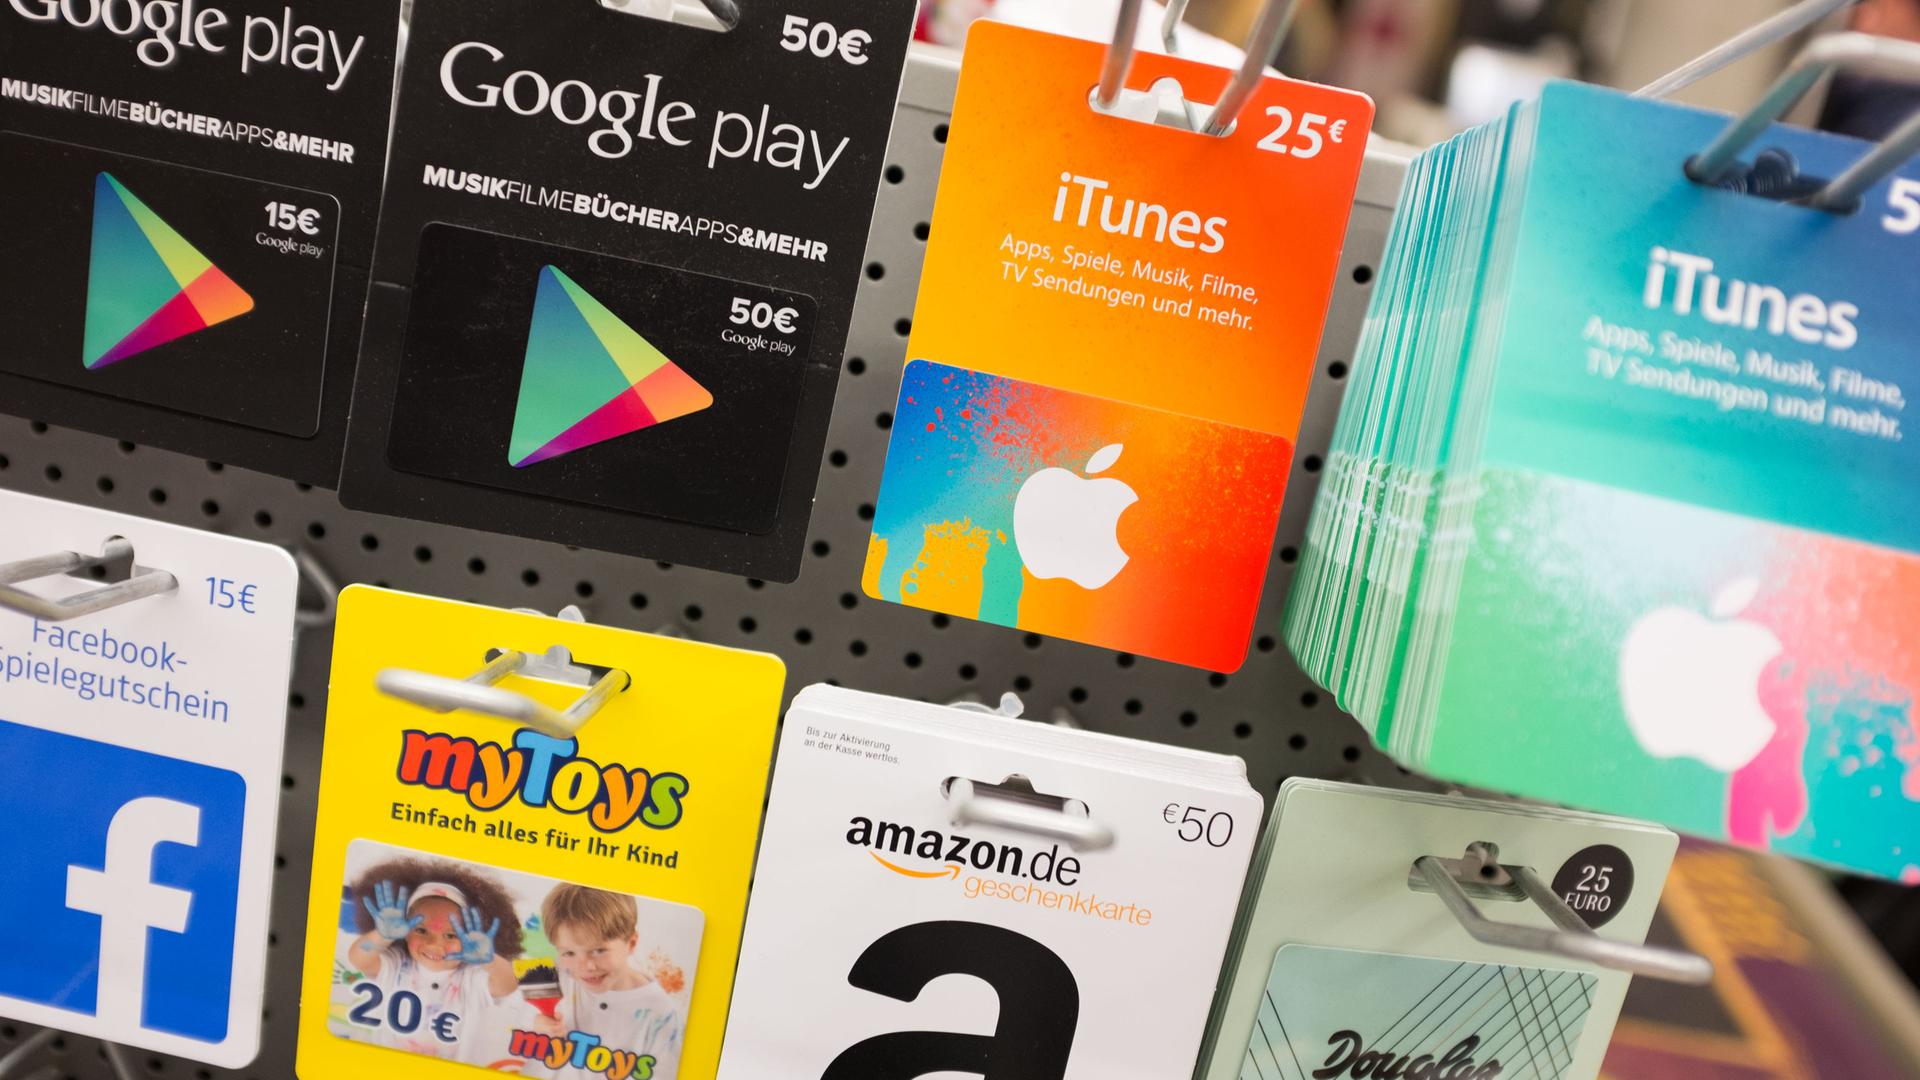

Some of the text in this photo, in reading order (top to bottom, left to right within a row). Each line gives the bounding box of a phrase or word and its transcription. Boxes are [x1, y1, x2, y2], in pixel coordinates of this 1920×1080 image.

[241, 6, 366, 91] play
[780, 14, 873, 65] 50€
[1, 77, 355, 164] MUSIKFILMEBÜCHERAPPS&MEHR
[440, 41, 850, 190] Google play
[1256, 105, 1347, 159] 25€
[255, 232, 324, 259] Google play
[264, 201, 321, 235] 15€
[422, 164, 829, 262] MUSIKFILMEBÜCHERAPPS&MEHR
[1053, 171, 1228, 254] iTunes
[1000, 233, 1260, 305] Apps, Spiele, Musik, Filme,
[1000, 261, 1254, 331] TV Sendungen und mehr.
[1643, 245, 1859, 350] iTunes
[721, 329, 797, 357] Google play
[729, 296, 799, 334] 50€
[1582, 315, 1906, 410] Apps, Spiele, Musik, Filme,
[1586, 346, 1903, 441] TV Sendungen und mehr.
[205, 576, 258, 614] 15€
[0, 646, 230, 723] pielegutschein
[803, 739, 815, 748] an
[817, 740, 833, 752] der
[835, 744, 863, 757] Kasse
[806, 726, 891, 752] Bis zur Aktivierung
[396, 727, 690, 833] myToys
[391, 802, 679, 870] Einfach alles für Ihr Kind
[846, 816, 1081, 886] amazon.de
[1163, 802, 1235, 848] €50
[963, 873, 1152, 927] geschenkkarte
[1576, 865, 1613, 893] 25
[508, 1029, 657, 1080] myToys
